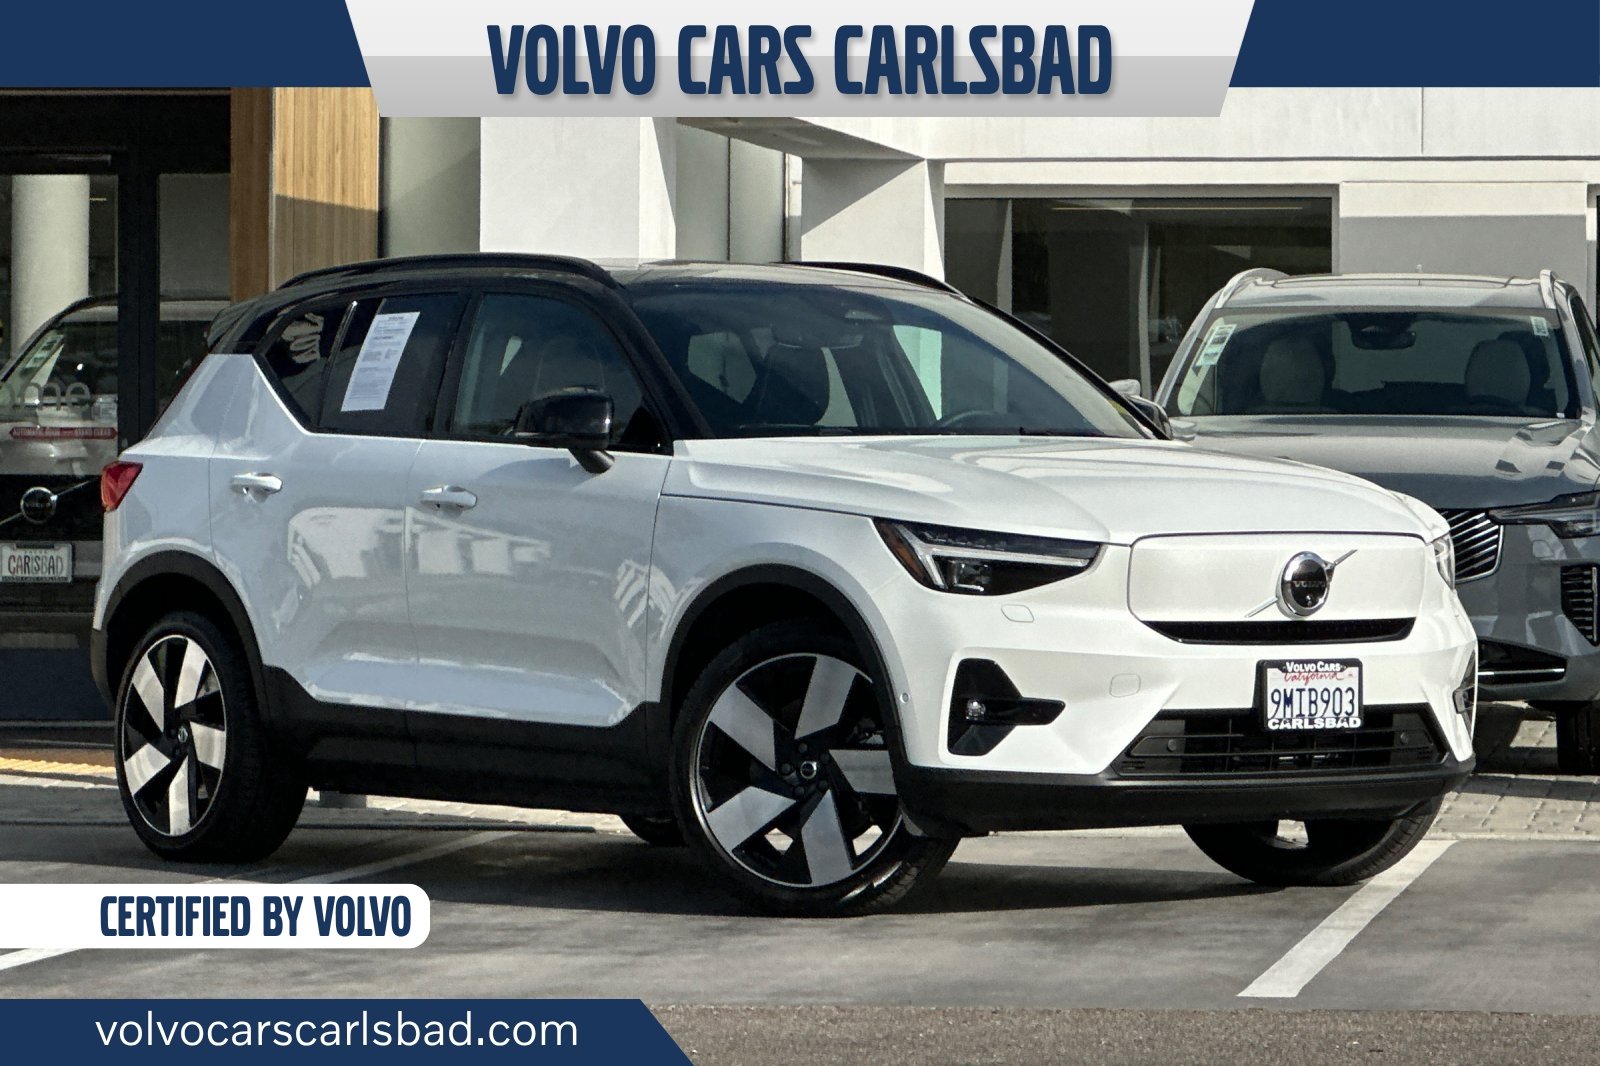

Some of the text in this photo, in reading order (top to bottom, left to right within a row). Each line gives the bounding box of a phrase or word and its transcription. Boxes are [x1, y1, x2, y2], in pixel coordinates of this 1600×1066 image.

[8, 554, 64, 575] CARLSBAD
[1271, 687, 1355, 719] 9MIB903
[1267, 717, 1362, 730] CARLSBAD
